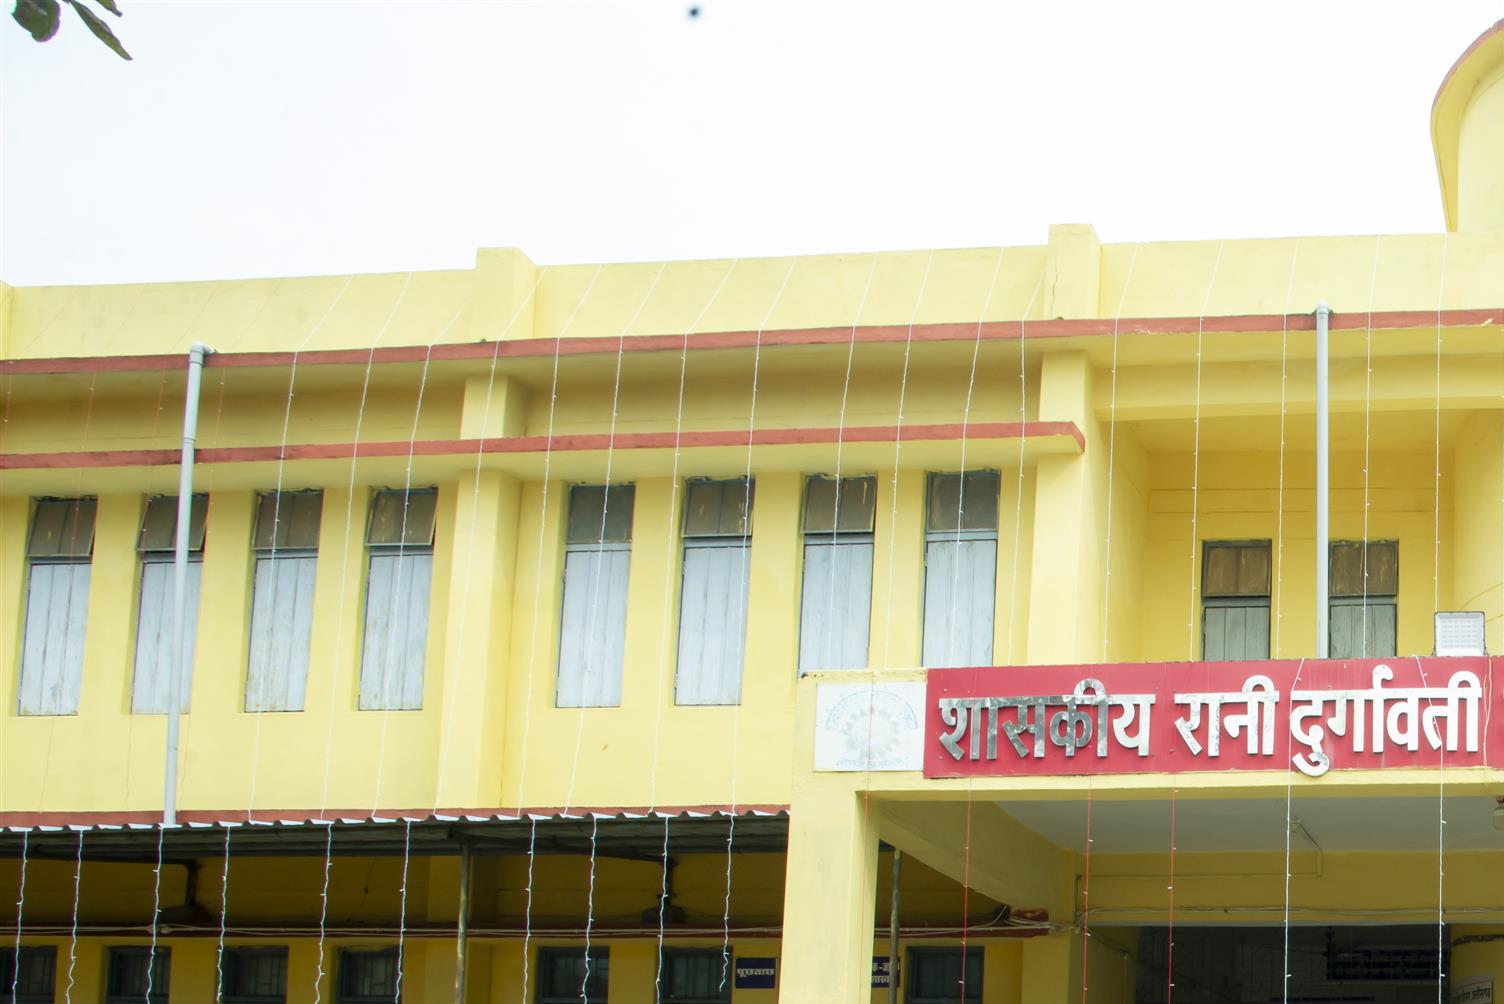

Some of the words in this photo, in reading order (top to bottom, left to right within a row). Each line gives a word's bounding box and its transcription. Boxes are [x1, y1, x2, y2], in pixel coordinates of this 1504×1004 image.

[939, 678, 1156, 761] शासकीय
[1174, 675, 1280, 757] रानी
[1290, 664, 1482, 777] दुर्गावती
